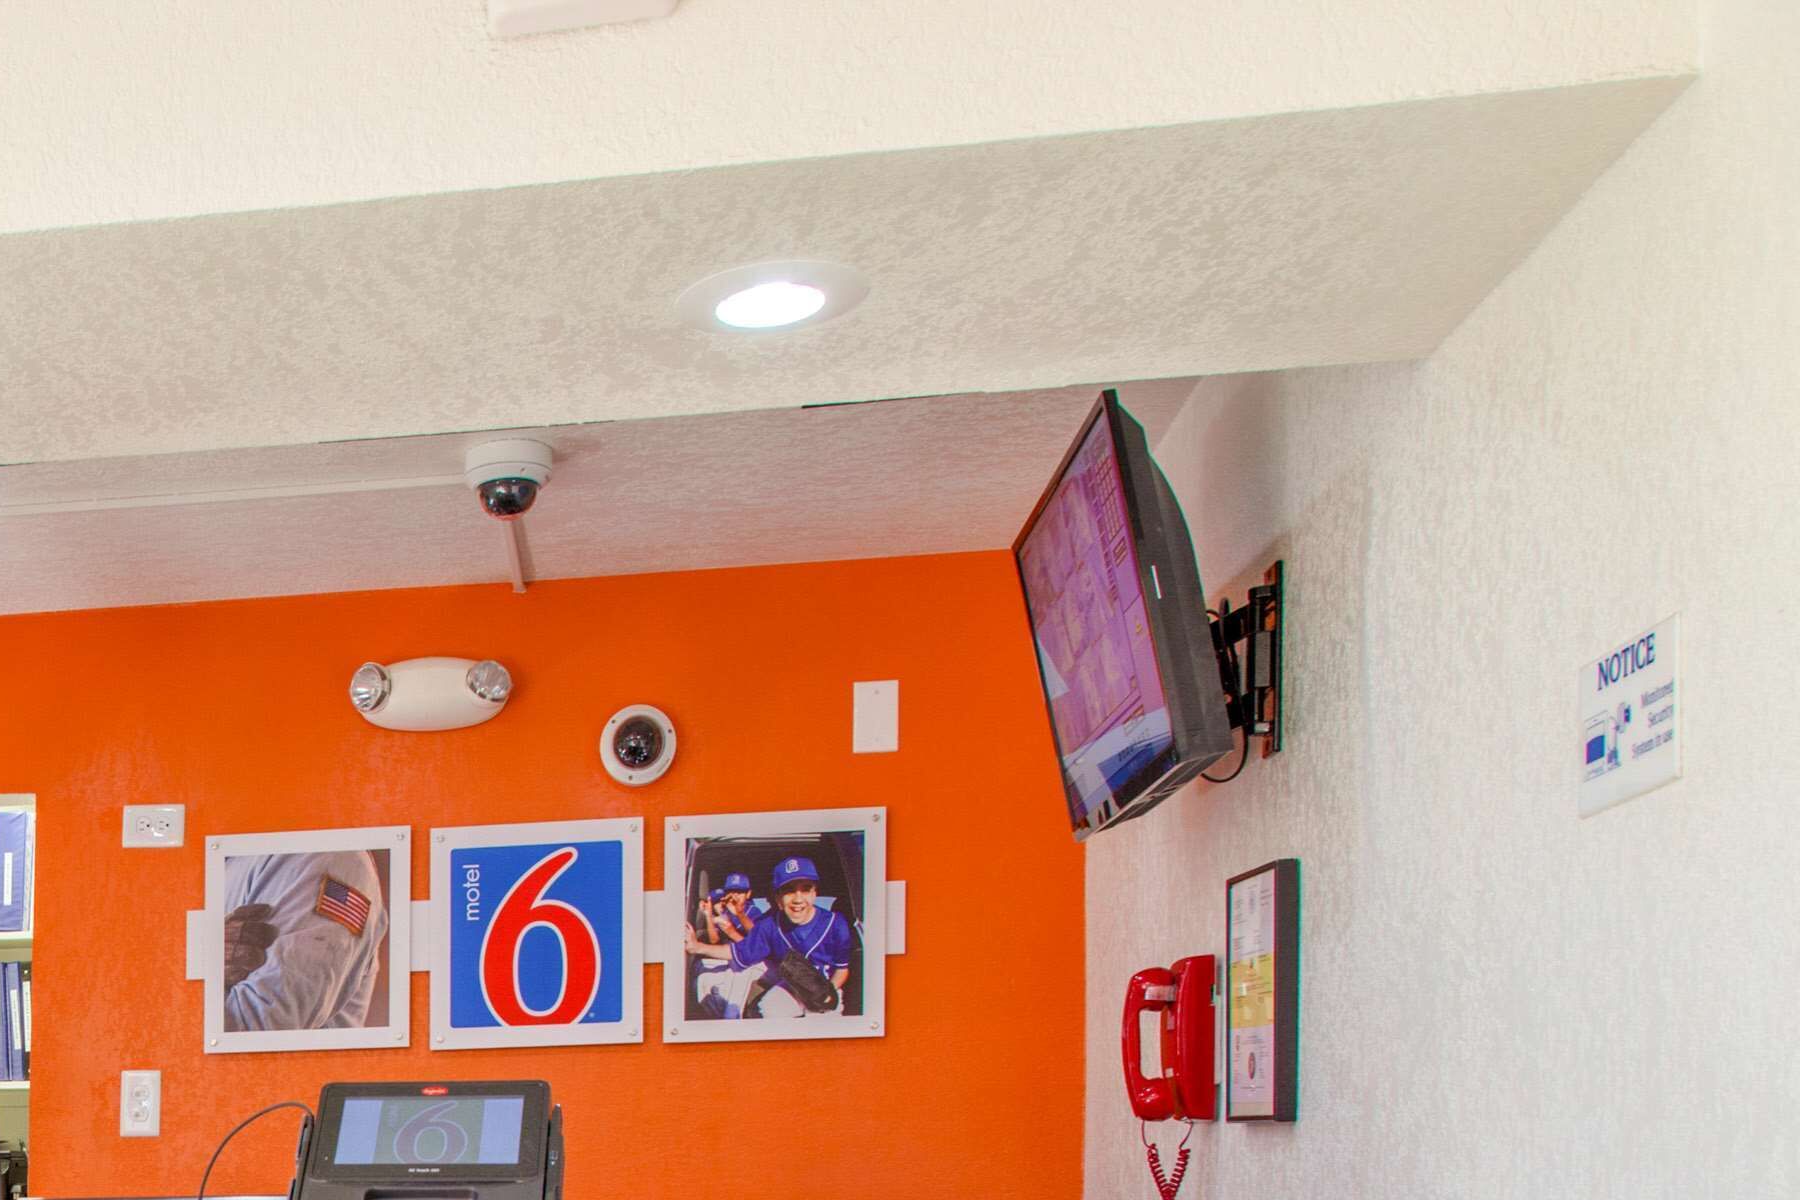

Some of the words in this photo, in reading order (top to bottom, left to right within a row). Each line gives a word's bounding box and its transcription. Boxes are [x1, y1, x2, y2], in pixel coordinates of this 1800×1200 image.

[1597, 632, 1656, 691] NOTICE
[462, 864, 480, 921] motel
[479, 846, 602, 1027] 6
